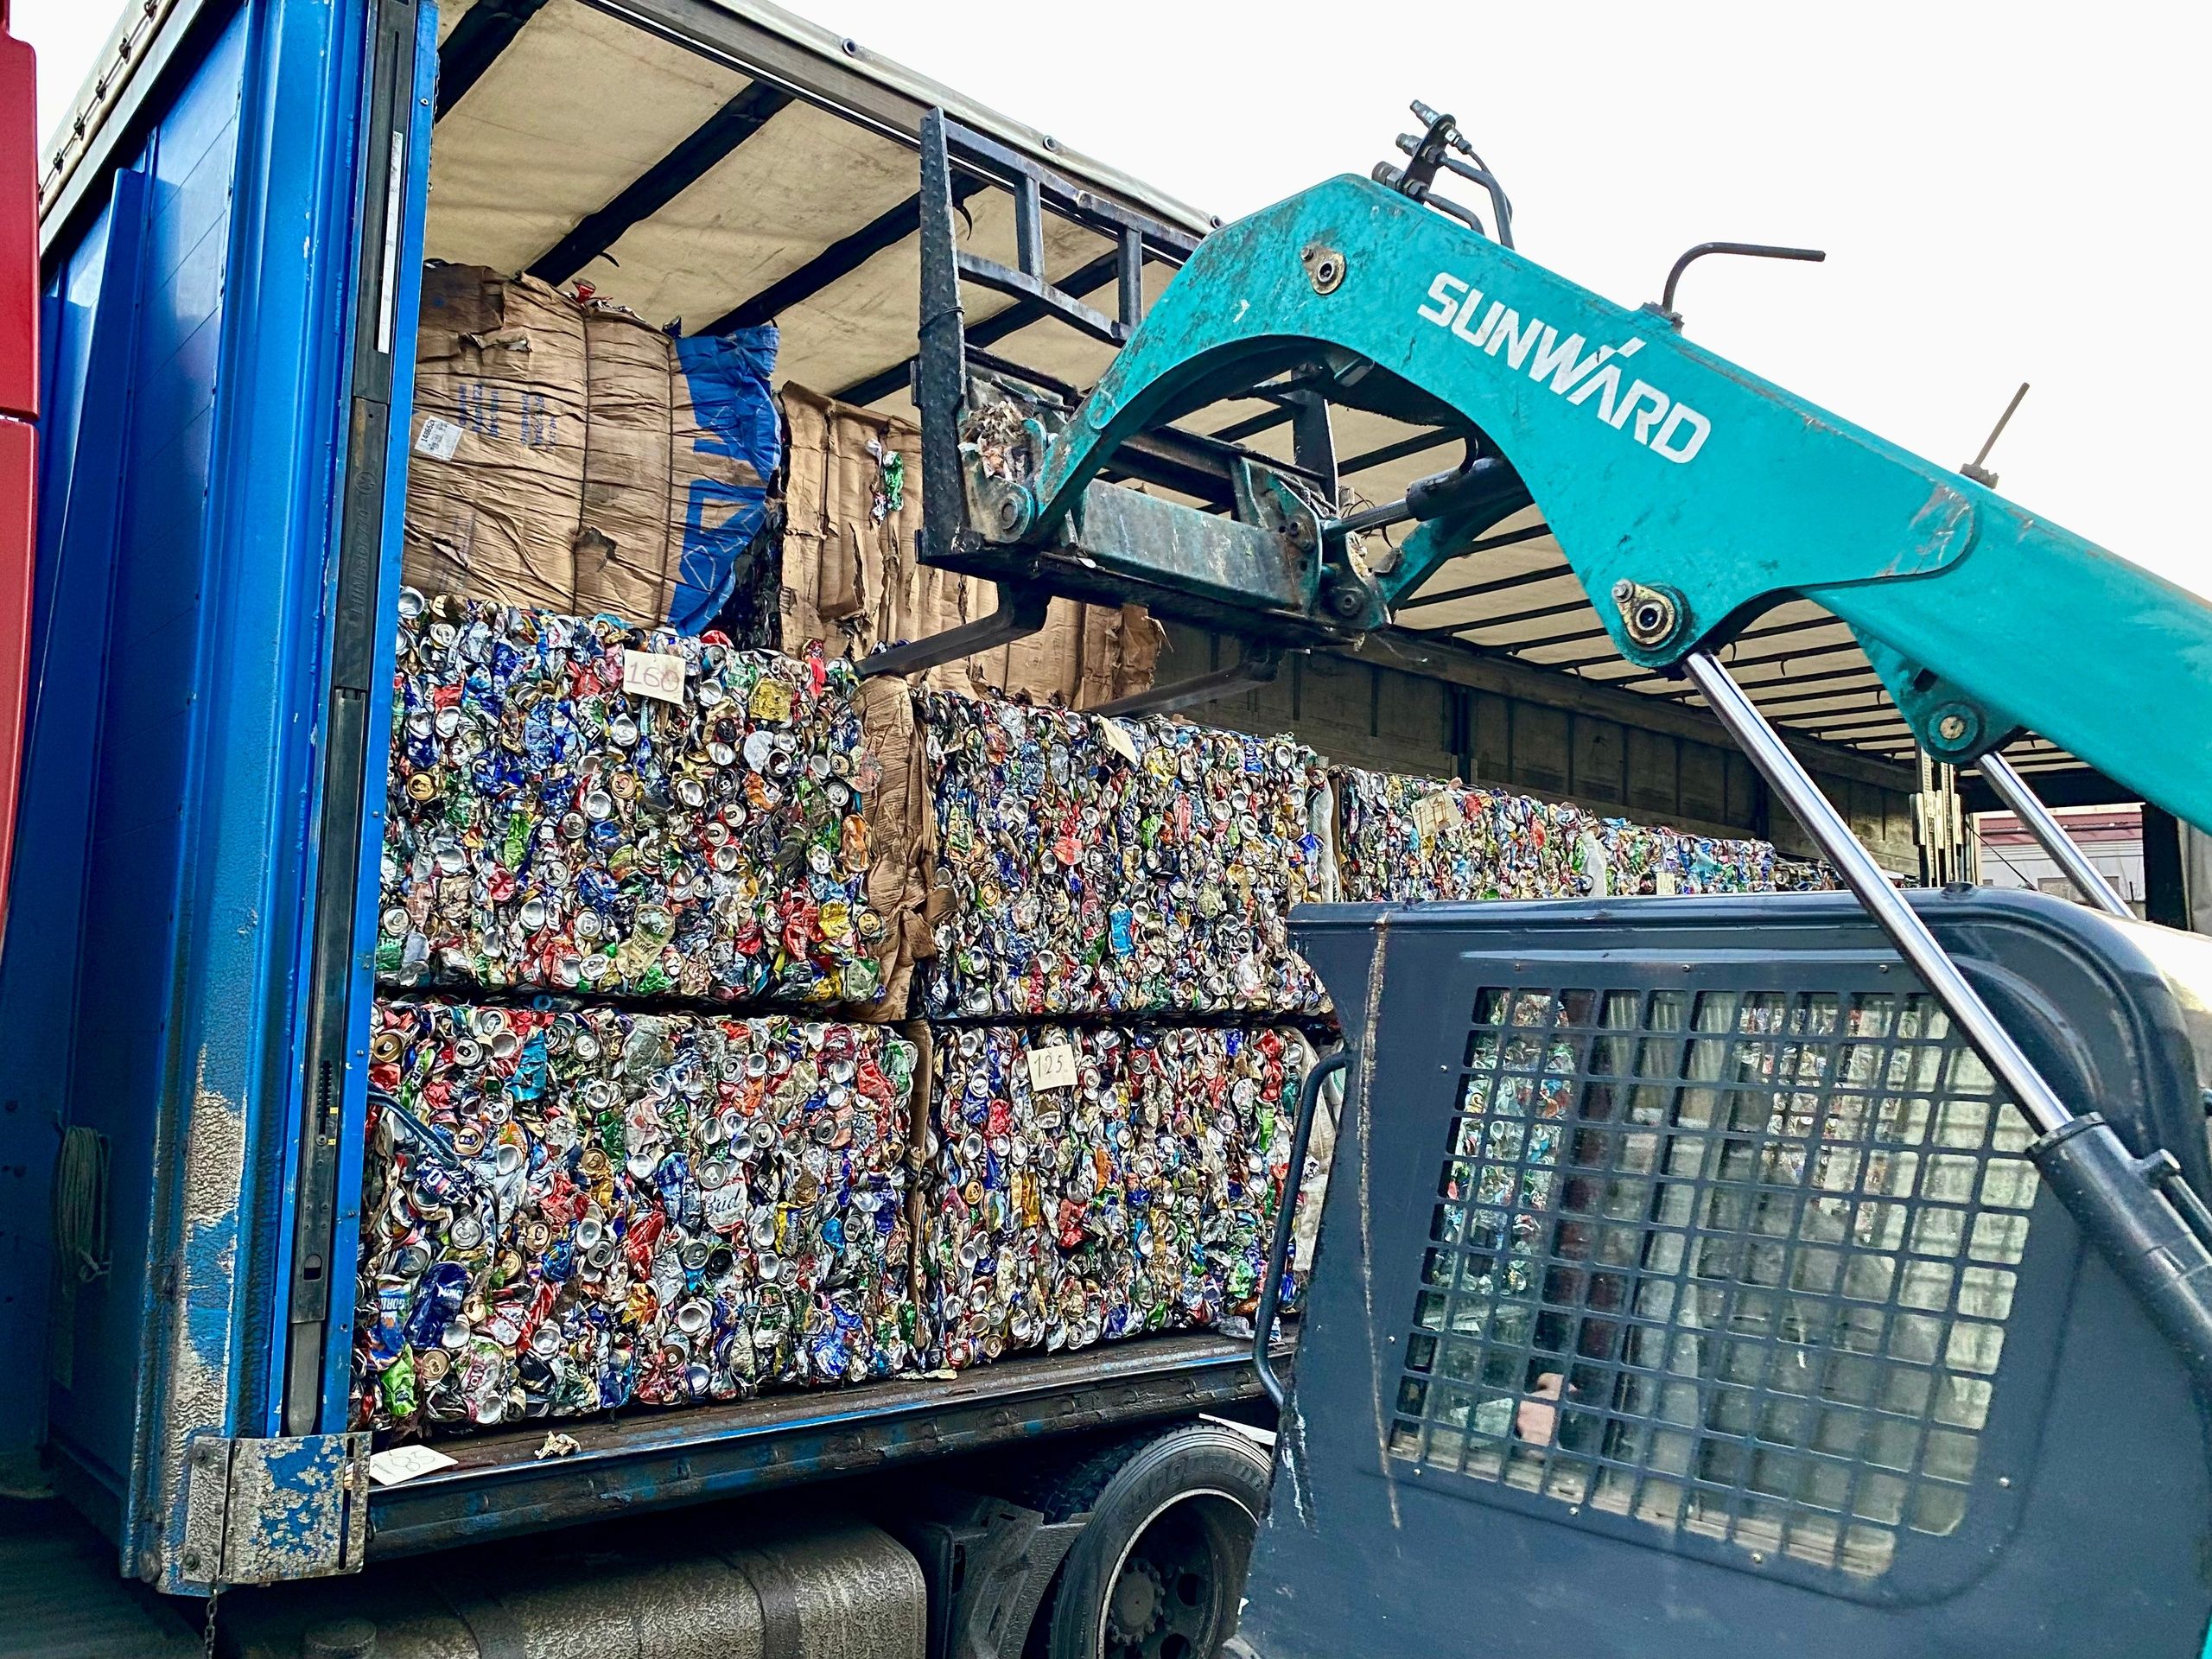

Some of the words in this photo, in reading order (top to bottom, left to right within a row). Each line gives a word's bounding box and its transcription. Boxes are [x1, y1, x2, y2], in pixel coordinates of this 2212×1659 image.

[1416, 271, 1712, 464] SUNWARD
[626, 661, 681, 693] 160
[1033, 1054, 1064, 1079] 125
